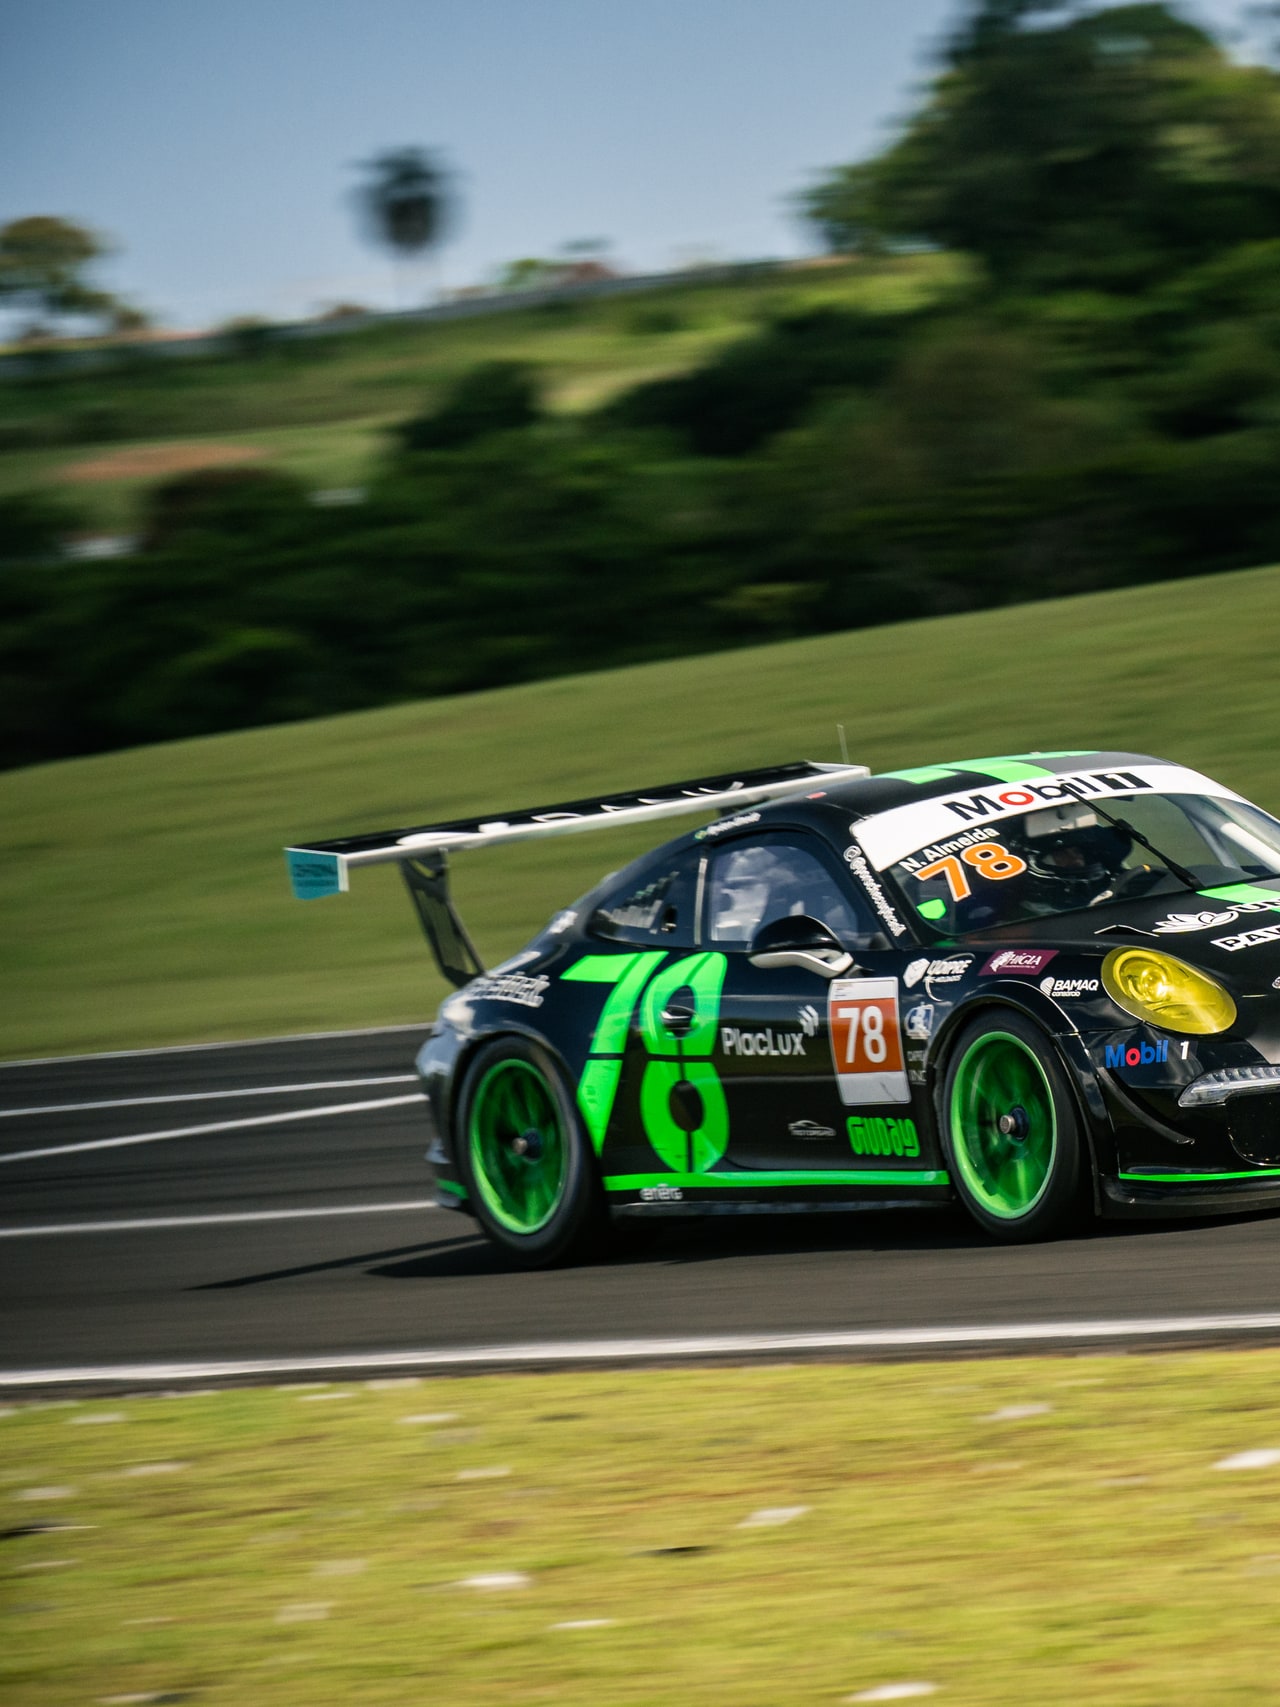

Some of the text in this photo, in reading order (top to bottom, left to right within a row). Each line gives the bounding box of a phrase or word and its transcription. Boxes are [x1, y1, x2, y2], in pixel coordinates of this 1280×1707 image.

[943, 777, 1102, 820] Mobil
[899, 828, 1001, 872] N. Almeida
[912, 842, 1028, 902] 78
[1053, 979, 1099, 992] BAMAQ
[720, 1027, 807, 1056] PlacLux
[837, 1005, 888, 1064] 78
[1105, 1040, 1190, 1069] Mobil 1
[559, 951, 730, 1173] 78
